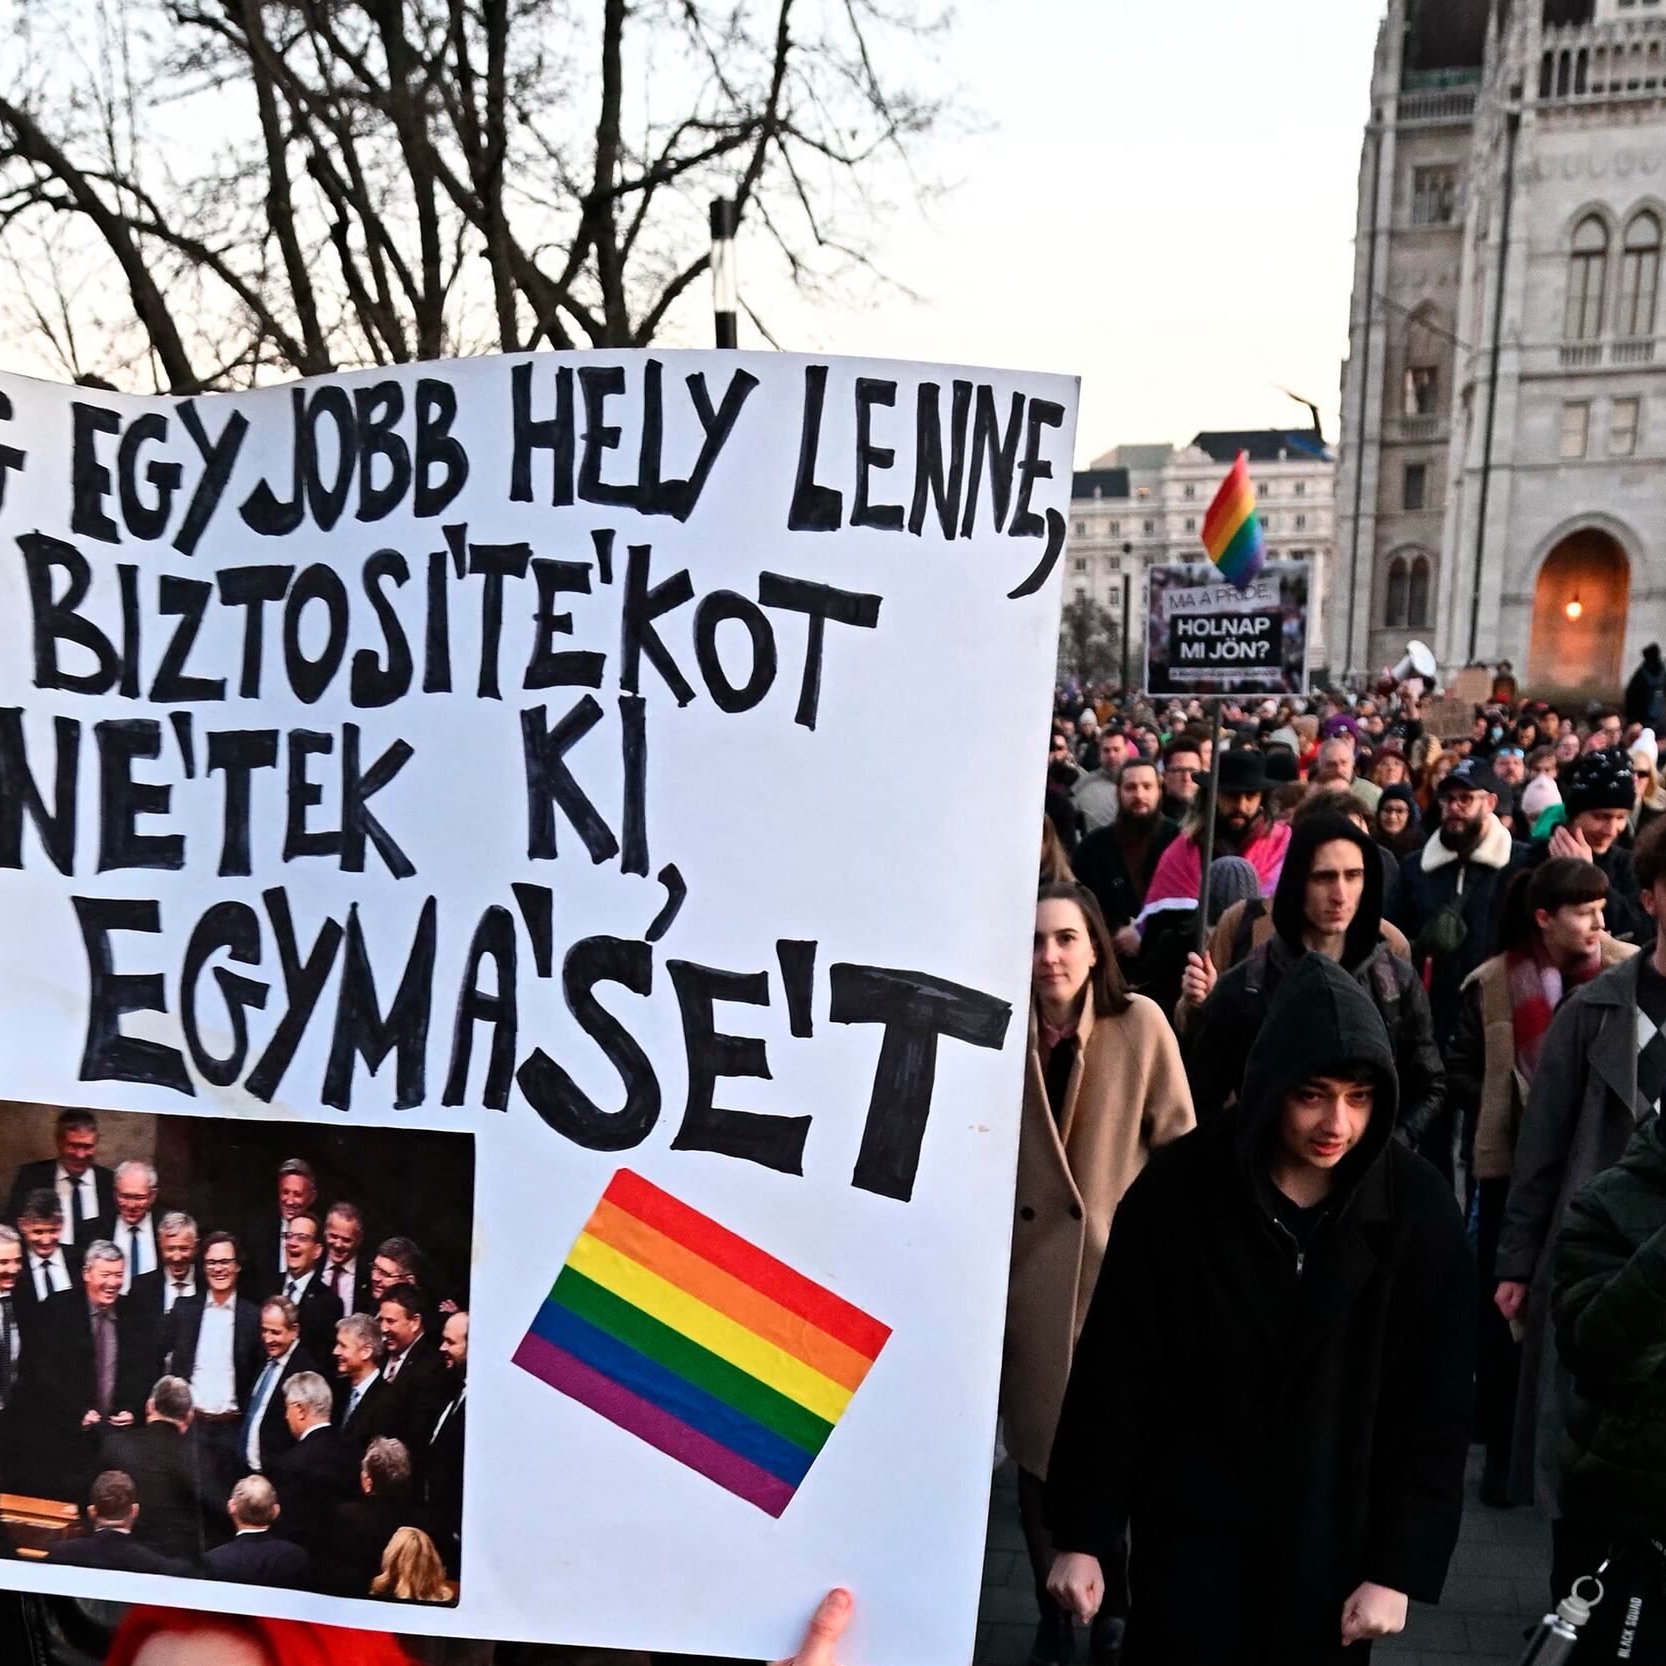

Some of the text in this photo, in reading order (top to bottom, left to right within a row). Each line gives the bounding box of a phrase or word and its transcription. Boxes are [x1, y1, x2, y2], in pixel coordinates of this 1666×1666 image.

[70, 396, 250, 556] EGY
[238, 378, 469, 537] JOBB
[509, 358, 760, 523] HELY
[788, 364, 1067, 600] LENNE,
[1169, 593, 1196, 609] MA
[1199, 591, 1212, 605] A
[1177, 617, 1270, 636] HOLNAP
[1180, 637, 1270, 659] MI JÖN?
[1617, 1597, 1642, 1658] BLACK SQUAD
